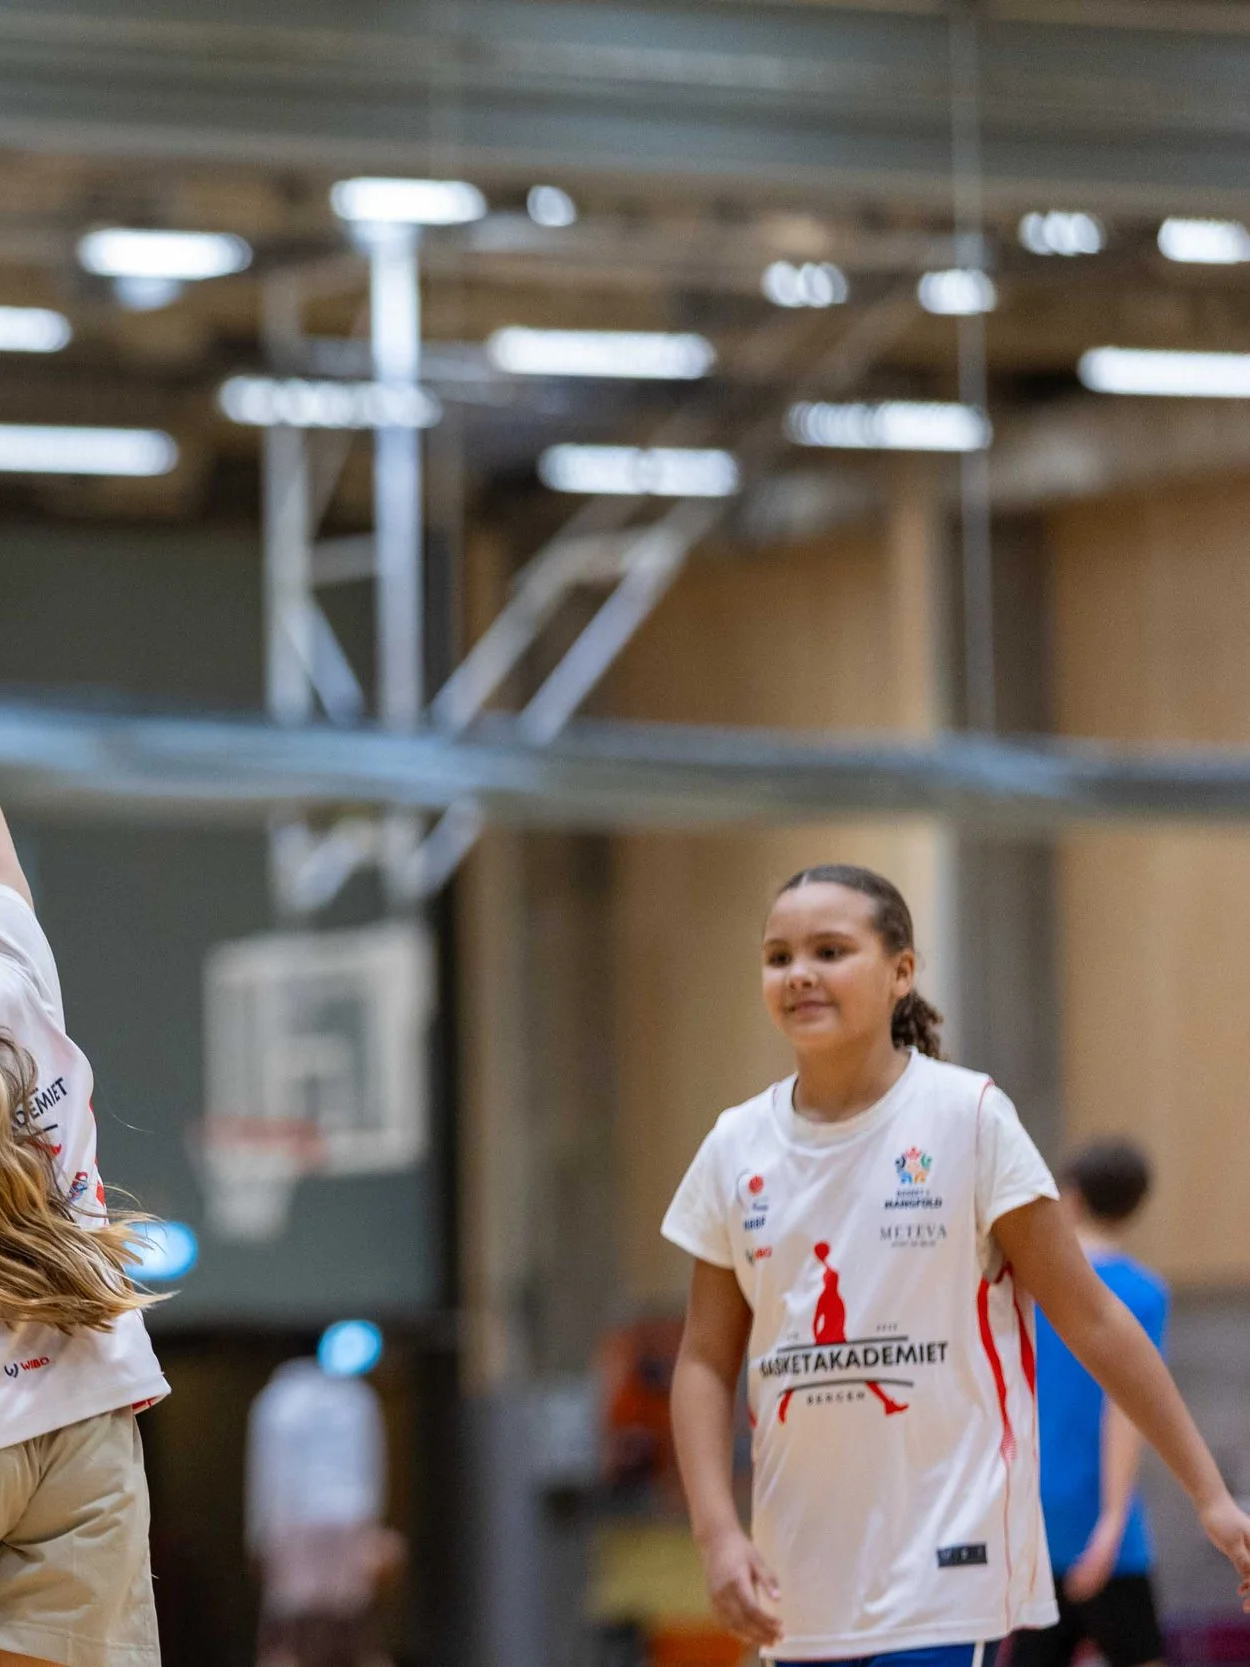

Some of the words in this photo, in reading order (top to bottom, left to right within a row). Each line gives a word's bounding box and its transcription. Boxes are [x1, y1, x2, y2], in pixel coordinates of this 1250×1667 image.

[13, 1077, 67, 1126] DEMIET
[879, 1223, 947, 1240] METEVA
[760, 1341, 948, 1379] BASKETAKADEMIET
